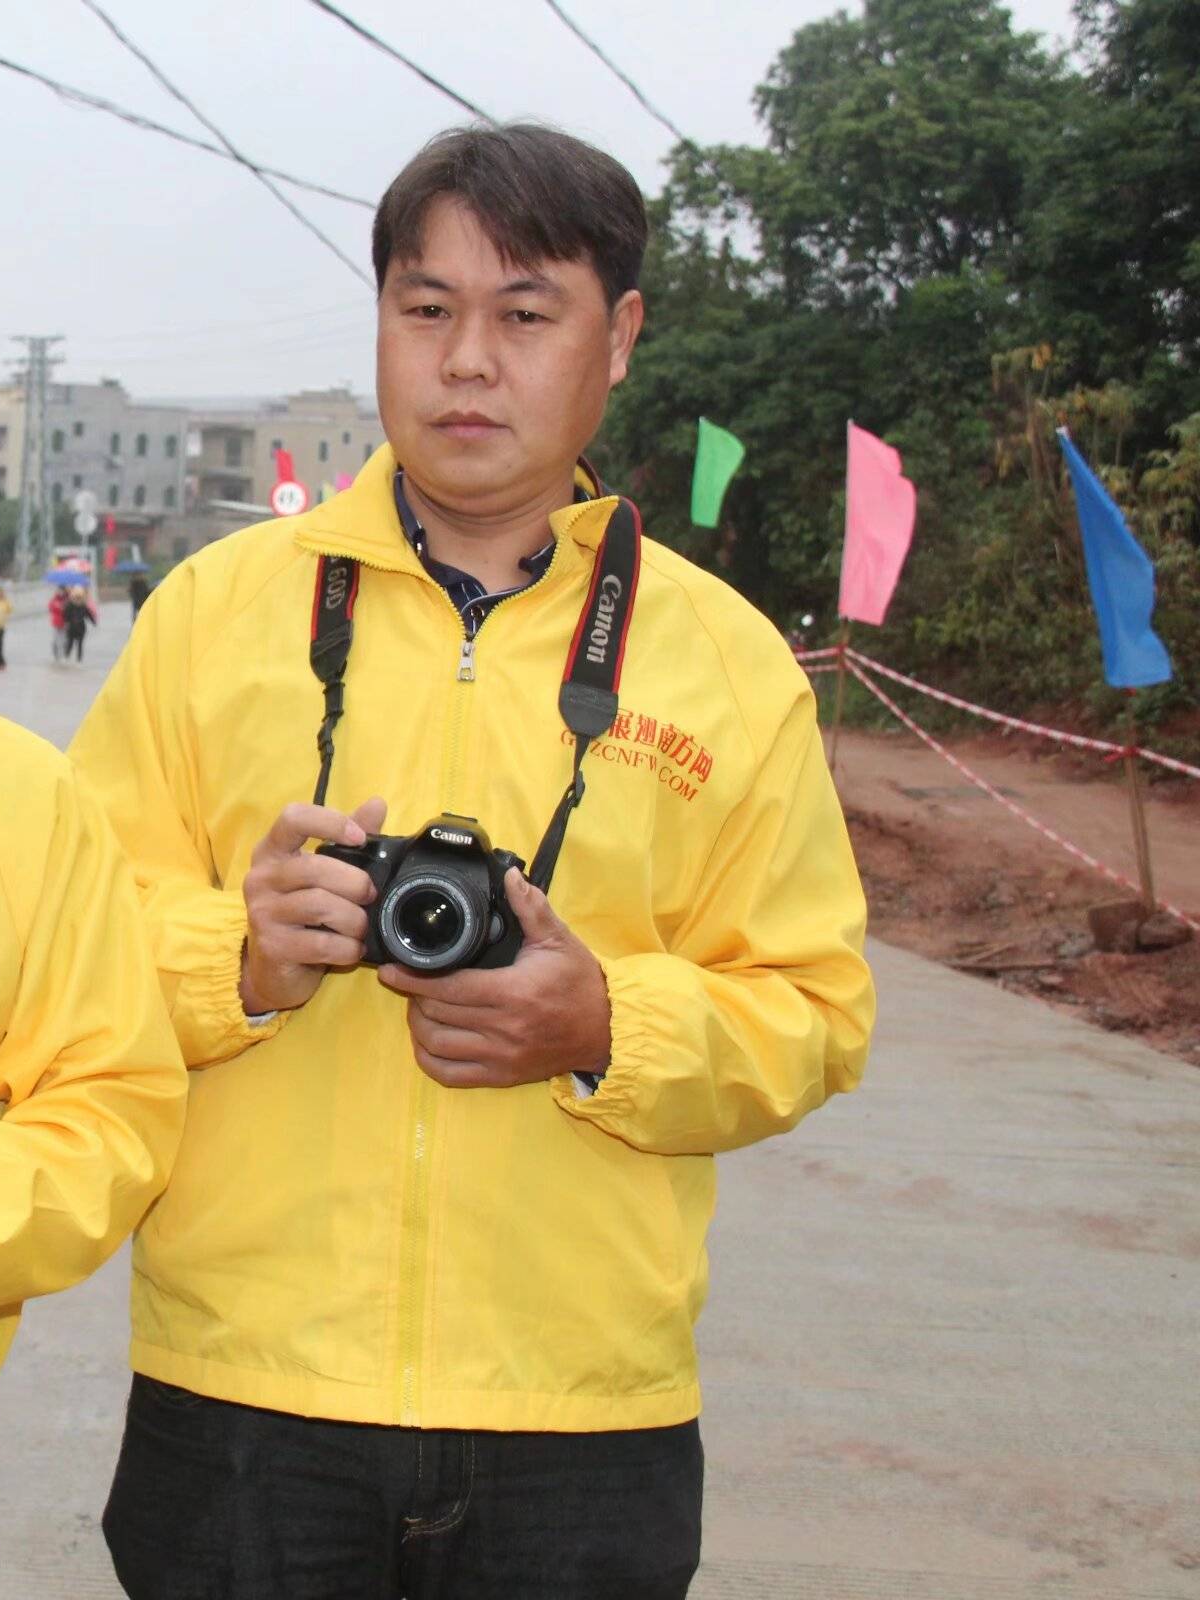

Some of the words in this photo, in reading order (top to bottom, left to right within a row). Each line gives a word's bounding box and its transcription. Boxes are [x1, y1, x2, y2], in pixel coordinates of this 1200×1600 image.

[325, 567, 347, 610] 60D
[586, 574, 623, 663] Canon
[430, 828, 473, 845] Canon
